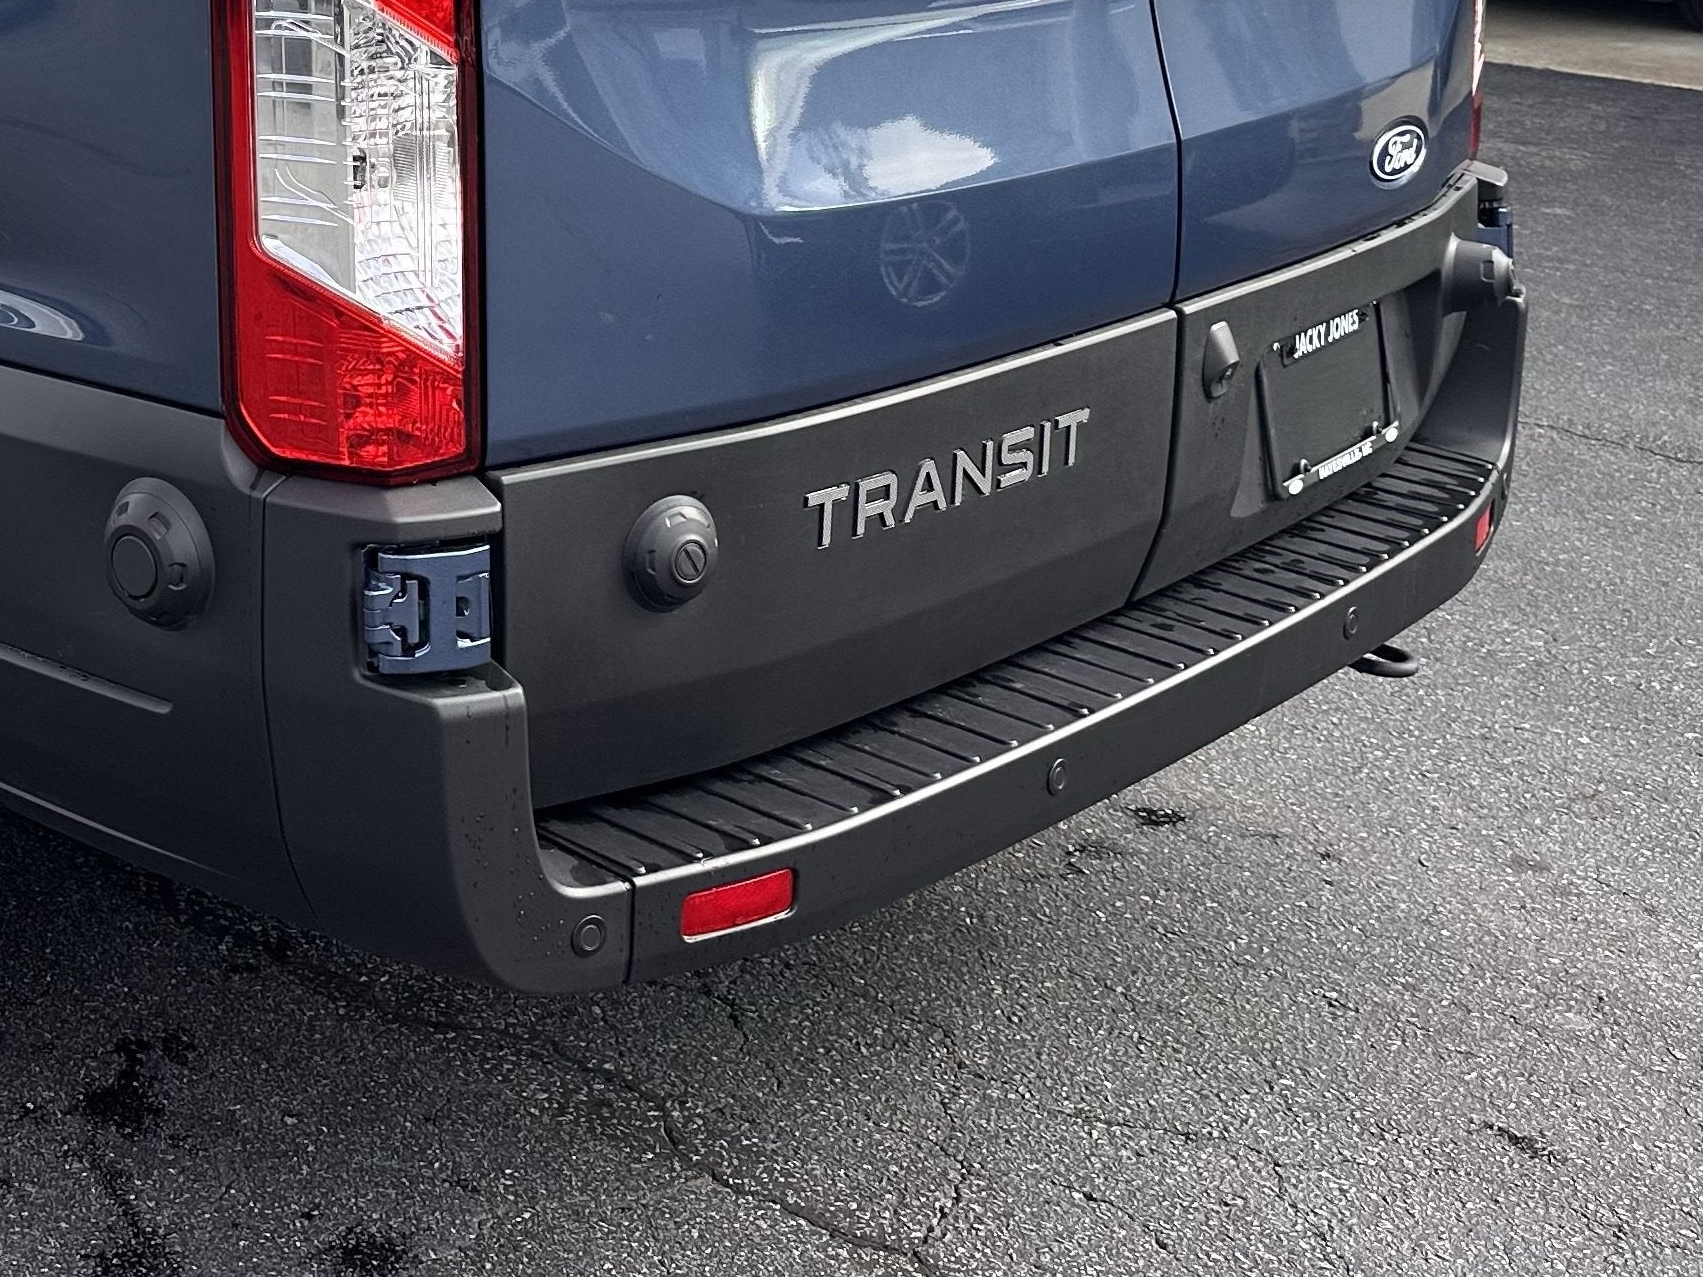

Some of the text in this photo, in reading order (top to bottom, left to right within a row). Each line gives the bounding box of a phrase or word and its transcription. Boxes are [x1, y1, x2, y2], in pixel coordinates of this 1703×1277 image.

[1384, 133, 1418, 173] Ford
[1293, 308, 1359, 359] JACKY JONES
[804, 406, 1091, 549] TRANSIT
